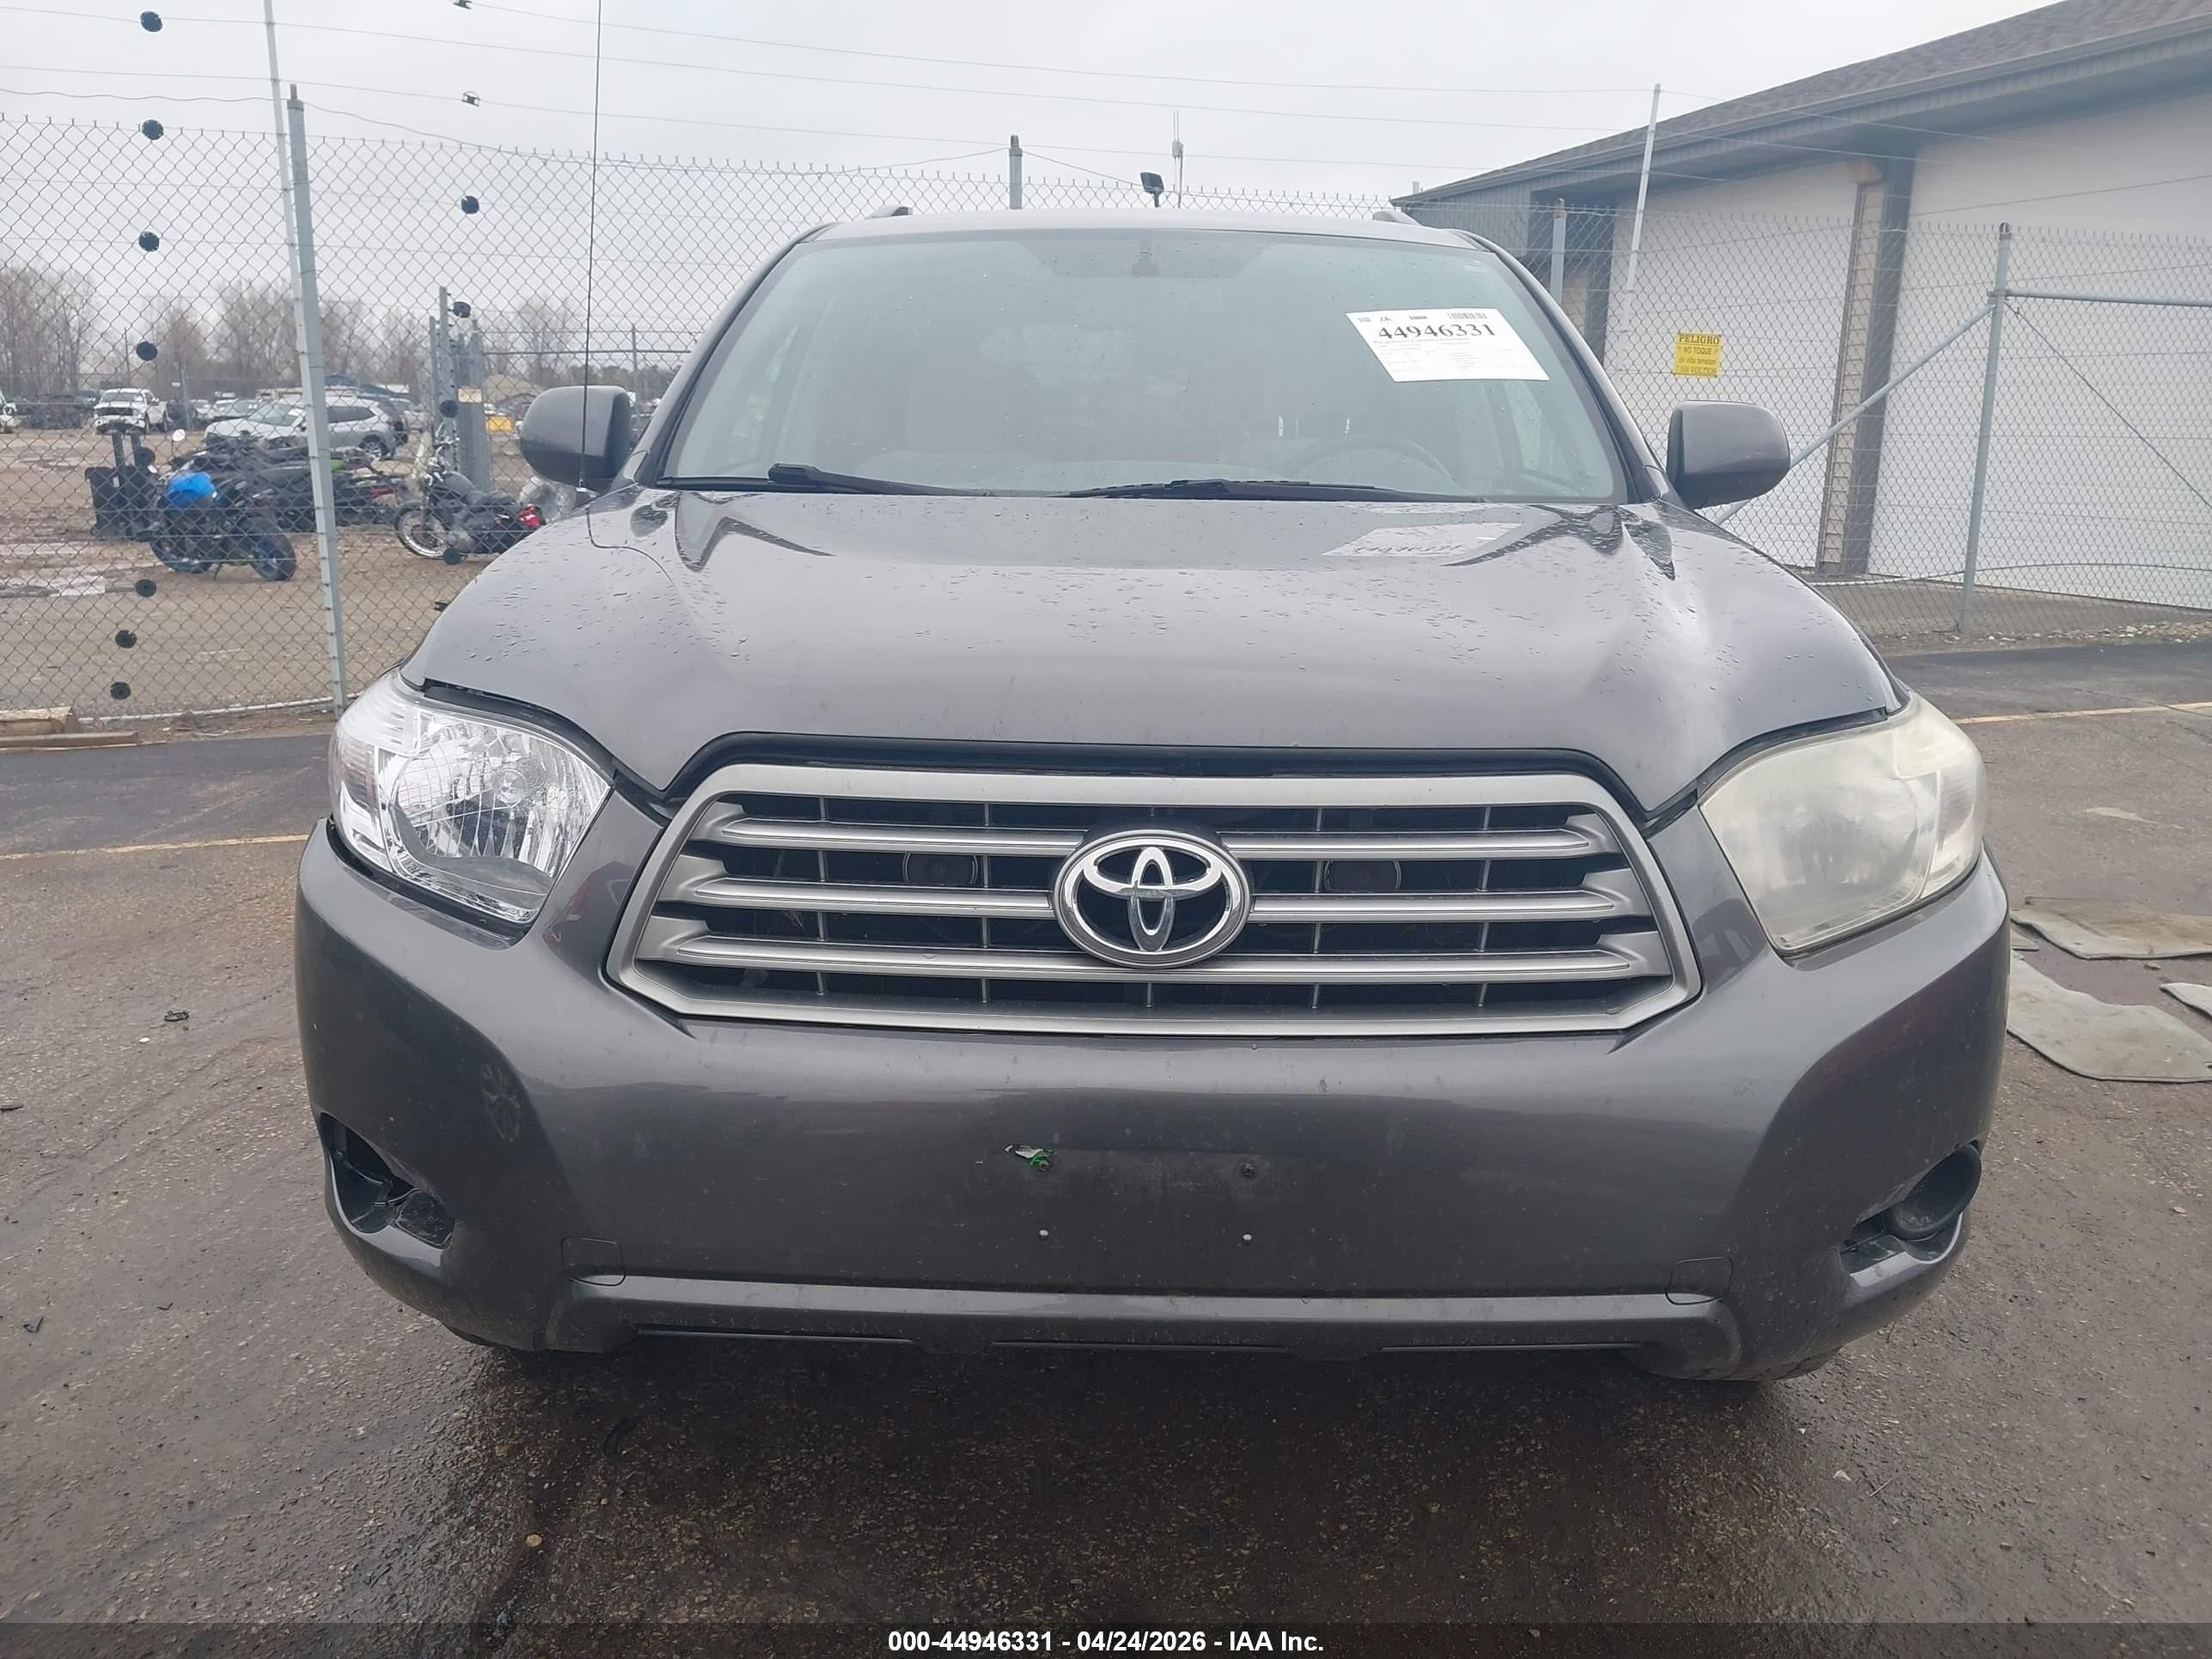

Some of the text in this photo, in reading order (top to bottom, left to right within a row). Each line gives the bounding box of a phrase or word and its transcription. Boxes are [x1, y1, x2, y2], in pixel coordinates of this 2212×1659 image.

[1378, 324, 1496, 338] 44946331
[1679, 335, 1720, 344] PELIGRO
[1692, 346, 1712, 355] TOQUE
